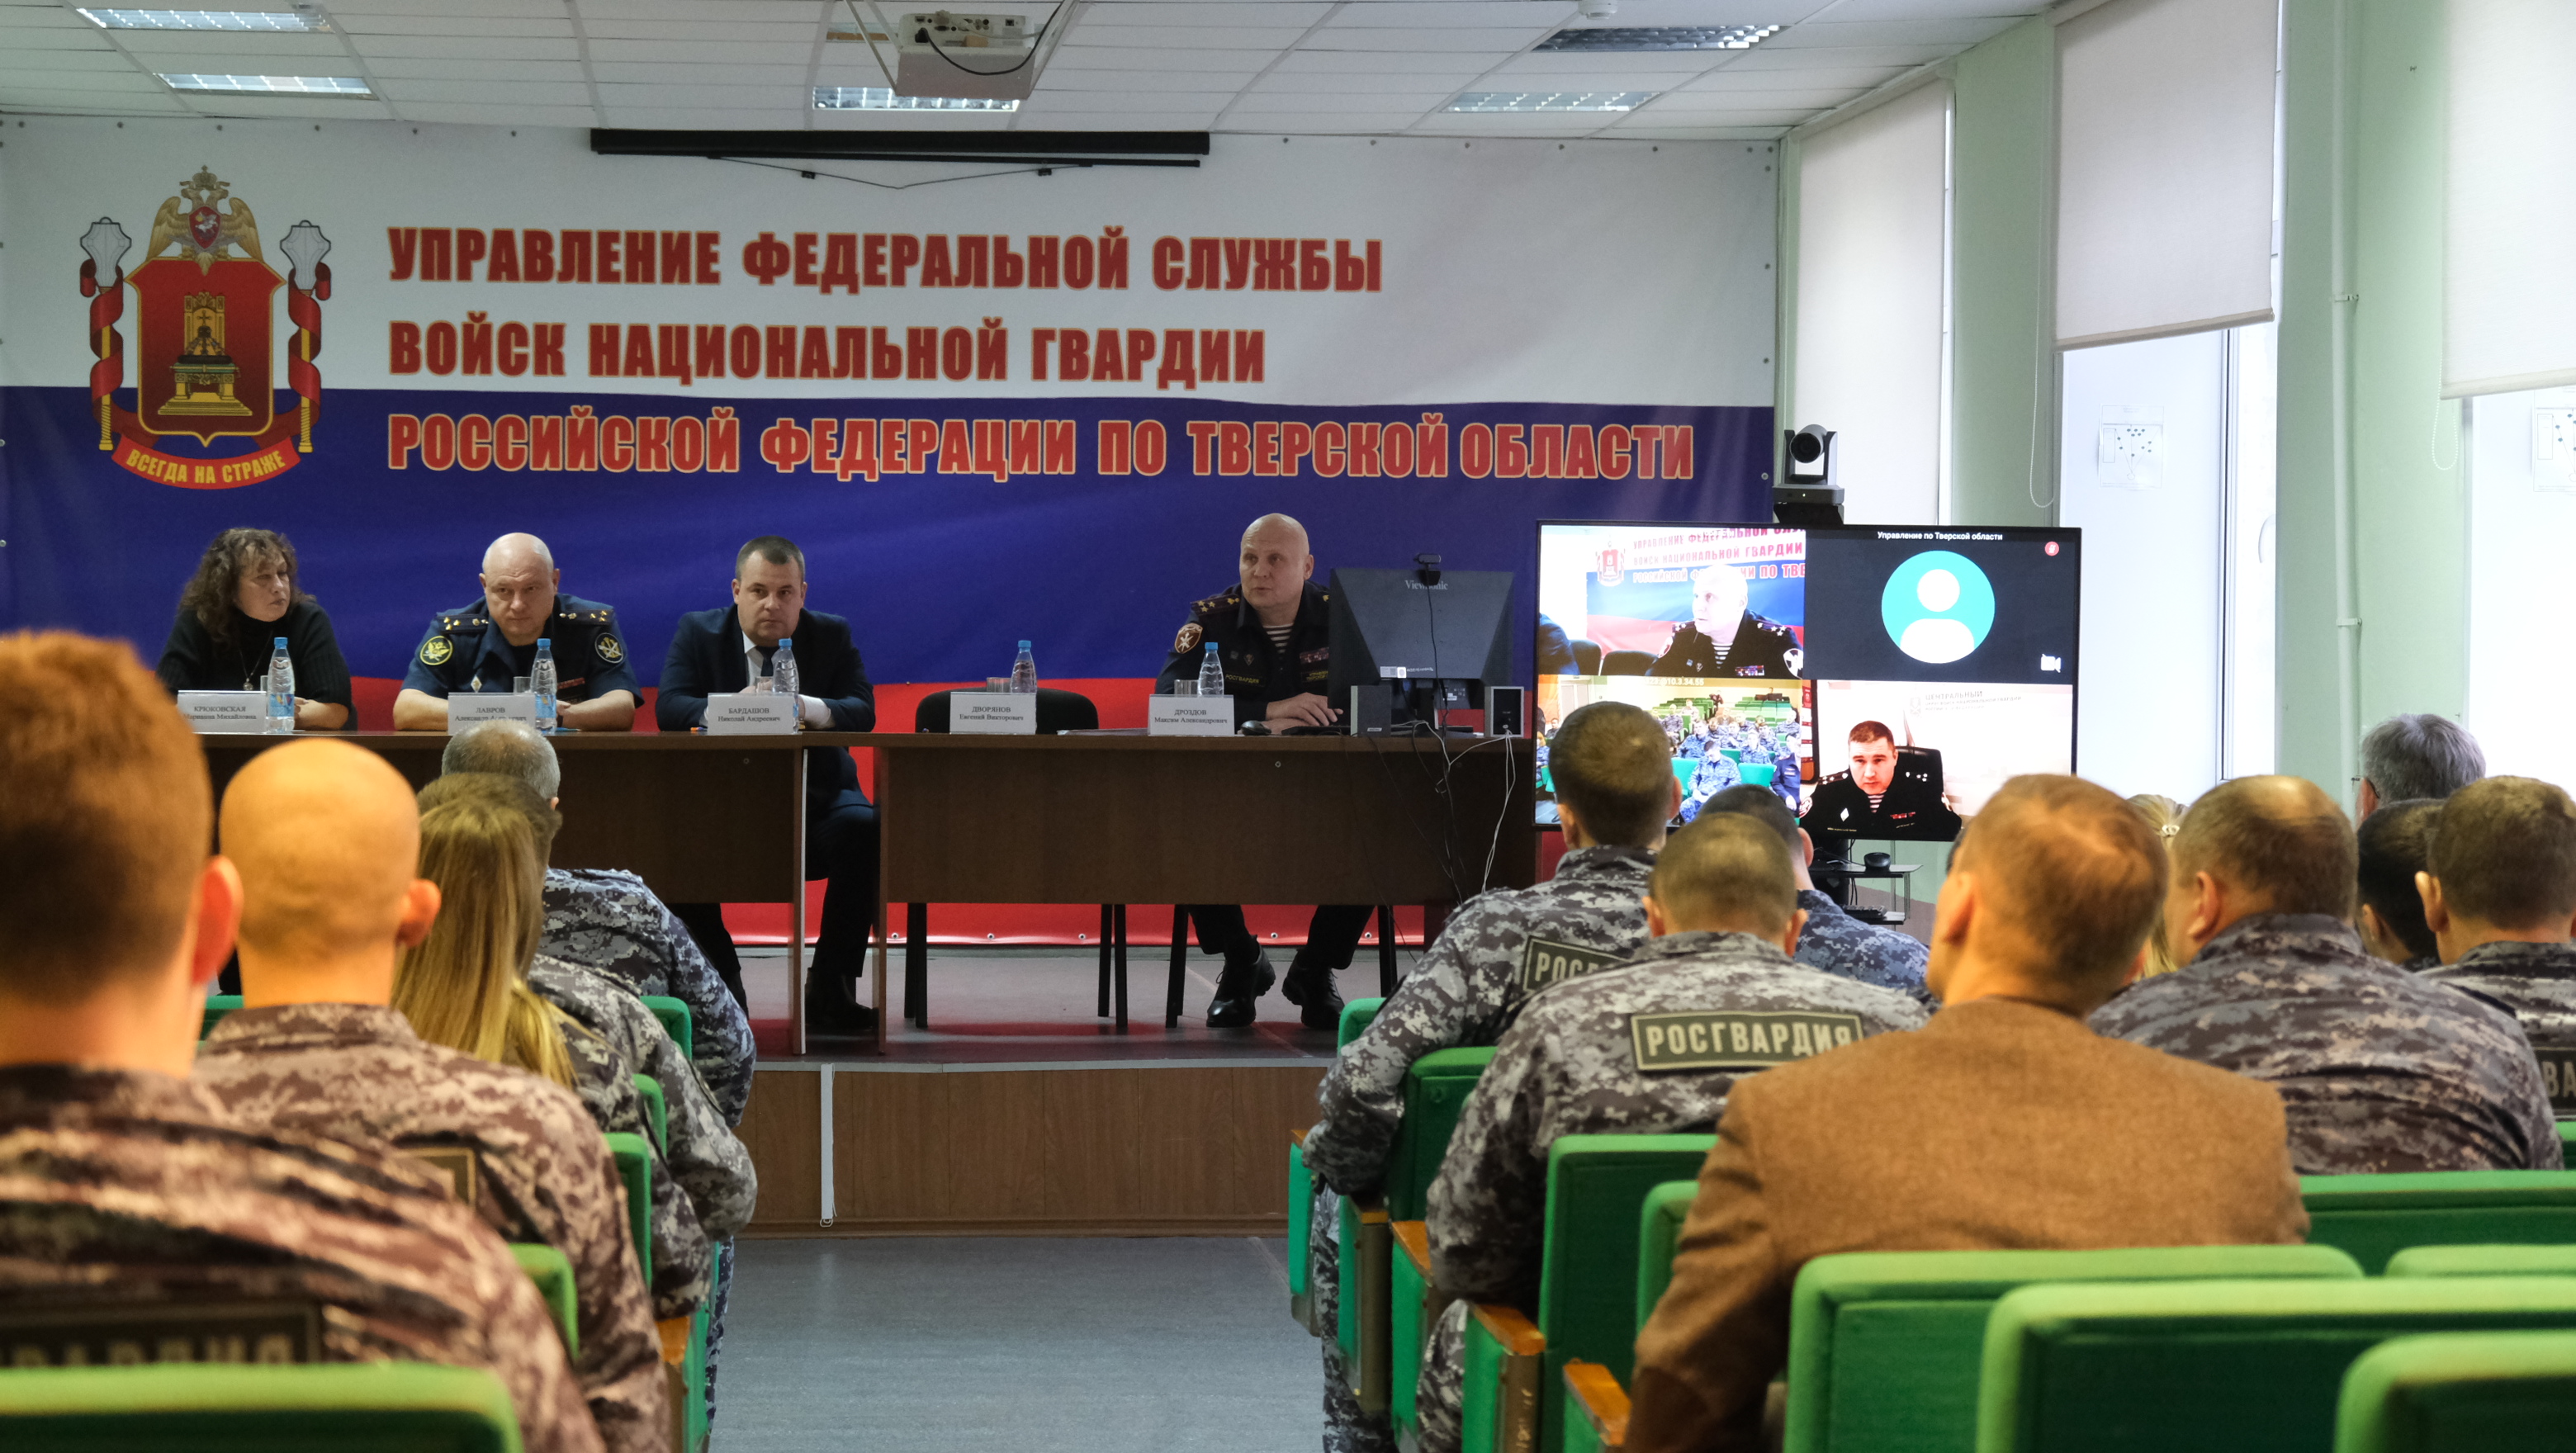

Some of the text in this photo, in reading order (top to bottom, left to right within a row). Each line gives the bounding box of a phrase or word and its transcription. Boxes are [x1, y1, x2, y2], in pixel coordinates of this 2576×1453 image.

[387, 225, 1382, 295] УПРАВЛЕНИЕ ФЕДЕРАЛЬНОЙ СЛУЖБЫ
[389, 311, 1265, 390] ВОЙСК НАЦИОНАЛЬНОЙ ГВАРДИИ
[387, 405, 1694, 482] РОССИЙСКОЙ ФЕДЕРАЦИИ ПО ТВЕРСКОЙ ОБЛАСТИ
[125, 448, 286, 484] ВСЕГДА НА СТРАЖЕ
[1745, 542, 1802, 557] ГВАРДИИ
[1877, 531, 1922, 540] Управление
[1935, 532, 1970, 541] Тверской
[1759, 565, 1778, 579] ПО
[1646, 1021, 1852, 1057] РОСГВАРДИЯ
